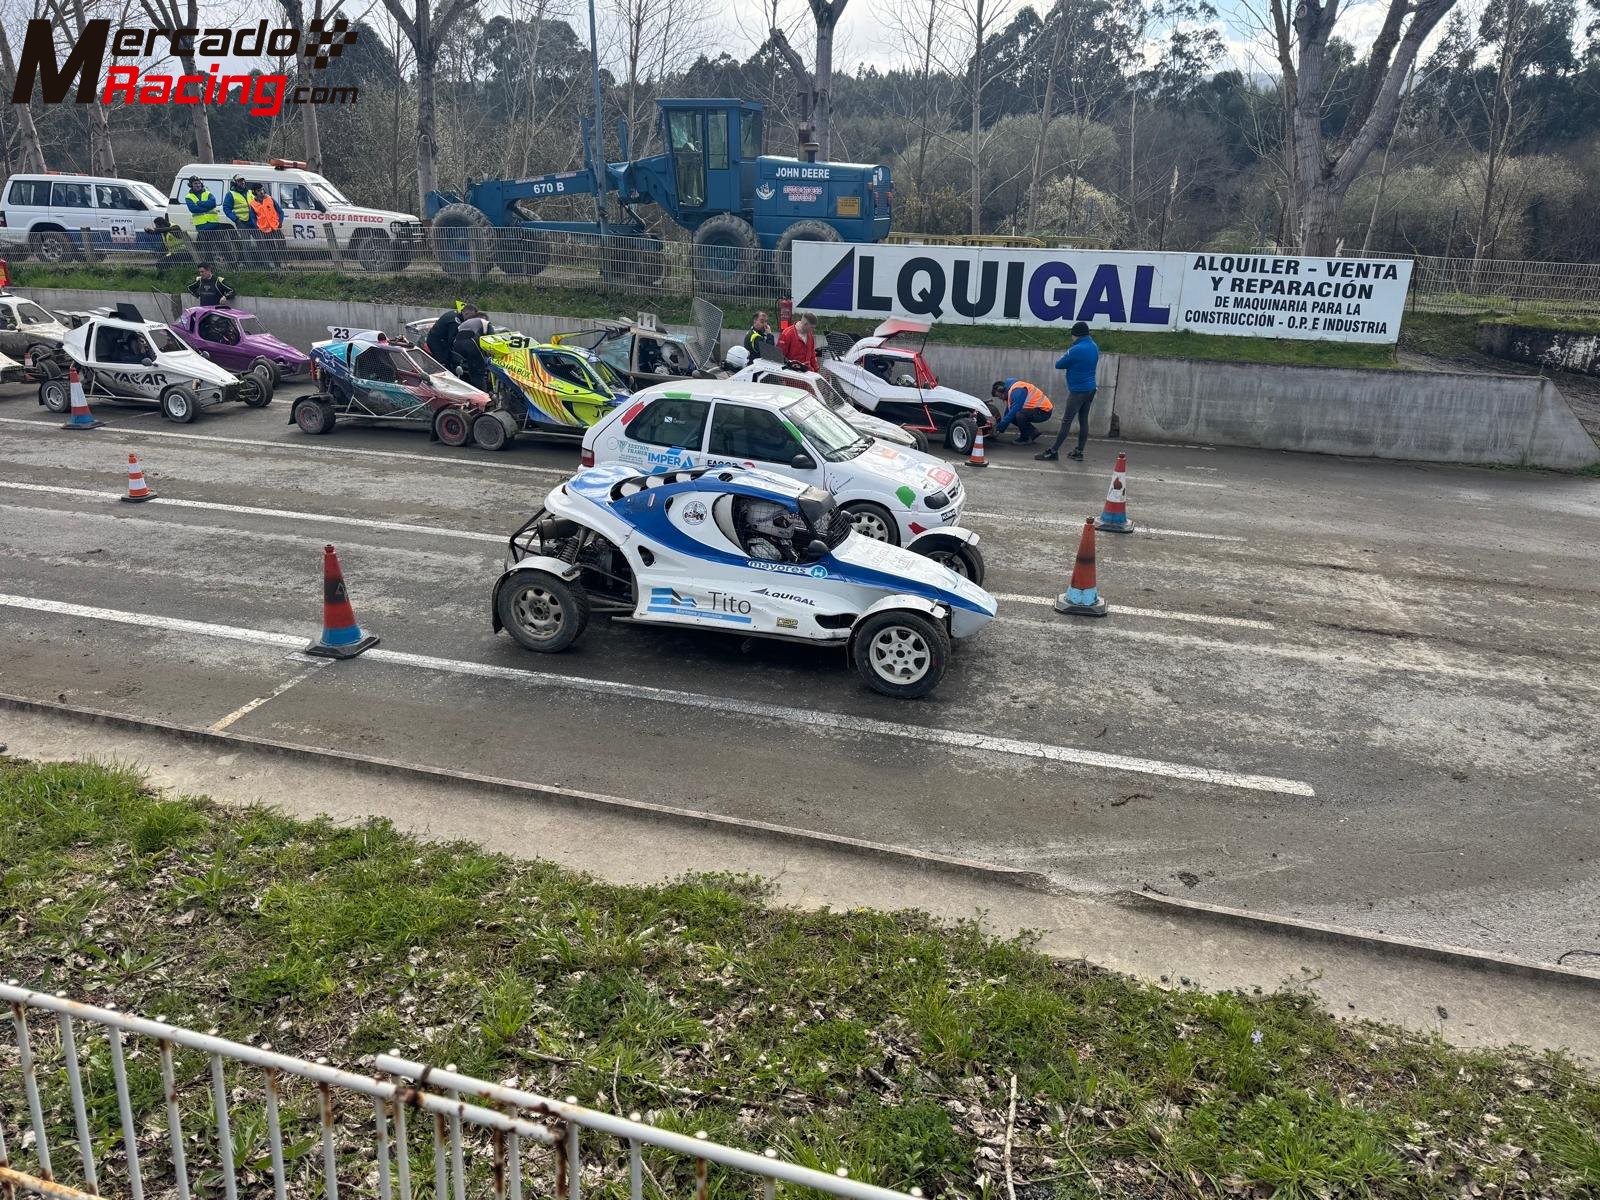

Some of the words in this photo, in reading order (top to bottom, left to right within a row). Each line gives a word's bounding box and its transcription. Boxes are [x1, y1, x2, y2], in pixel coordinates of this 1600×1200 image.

[776, 168, 799, 178] JOHN
[802, 169, 829, 178] DEERE
[533, 183, 553, 193] 670
[556, 182, 564, 191] B
[295, 213, 345, 221] AUTOCROSS
[348, 215, 383, 223] ARTEIXO
[112, 226, 126, 235] R1
[293, 225, 315, 239] R5
[1193, 256, 1300, 275] ALQUILER
[1327, 262, 1398, 280] VENTA
[1211, 277, 1224, 291] Y
[1231, 277, 1373, 299] REPARACIÓN
[1214, 296, 1230, 308] DE
[1233, 297, 1307, 313] MAQUINARIA
[1311, 302, 1342, 315] PARA
[1346, 304, 1361, 316] LA
[1185, 310, 1275, 327] CONSTRUCCIÓN
[1312, 319, 1319, 330] E
[1323, 320, 1388, 334] INDUSTRIA
[334, 328, 349, 339] 23
[509, 336, 530, 348] 31
[748, 561, 806, 575] mayores
[708, 591, 752, 615] Tito
